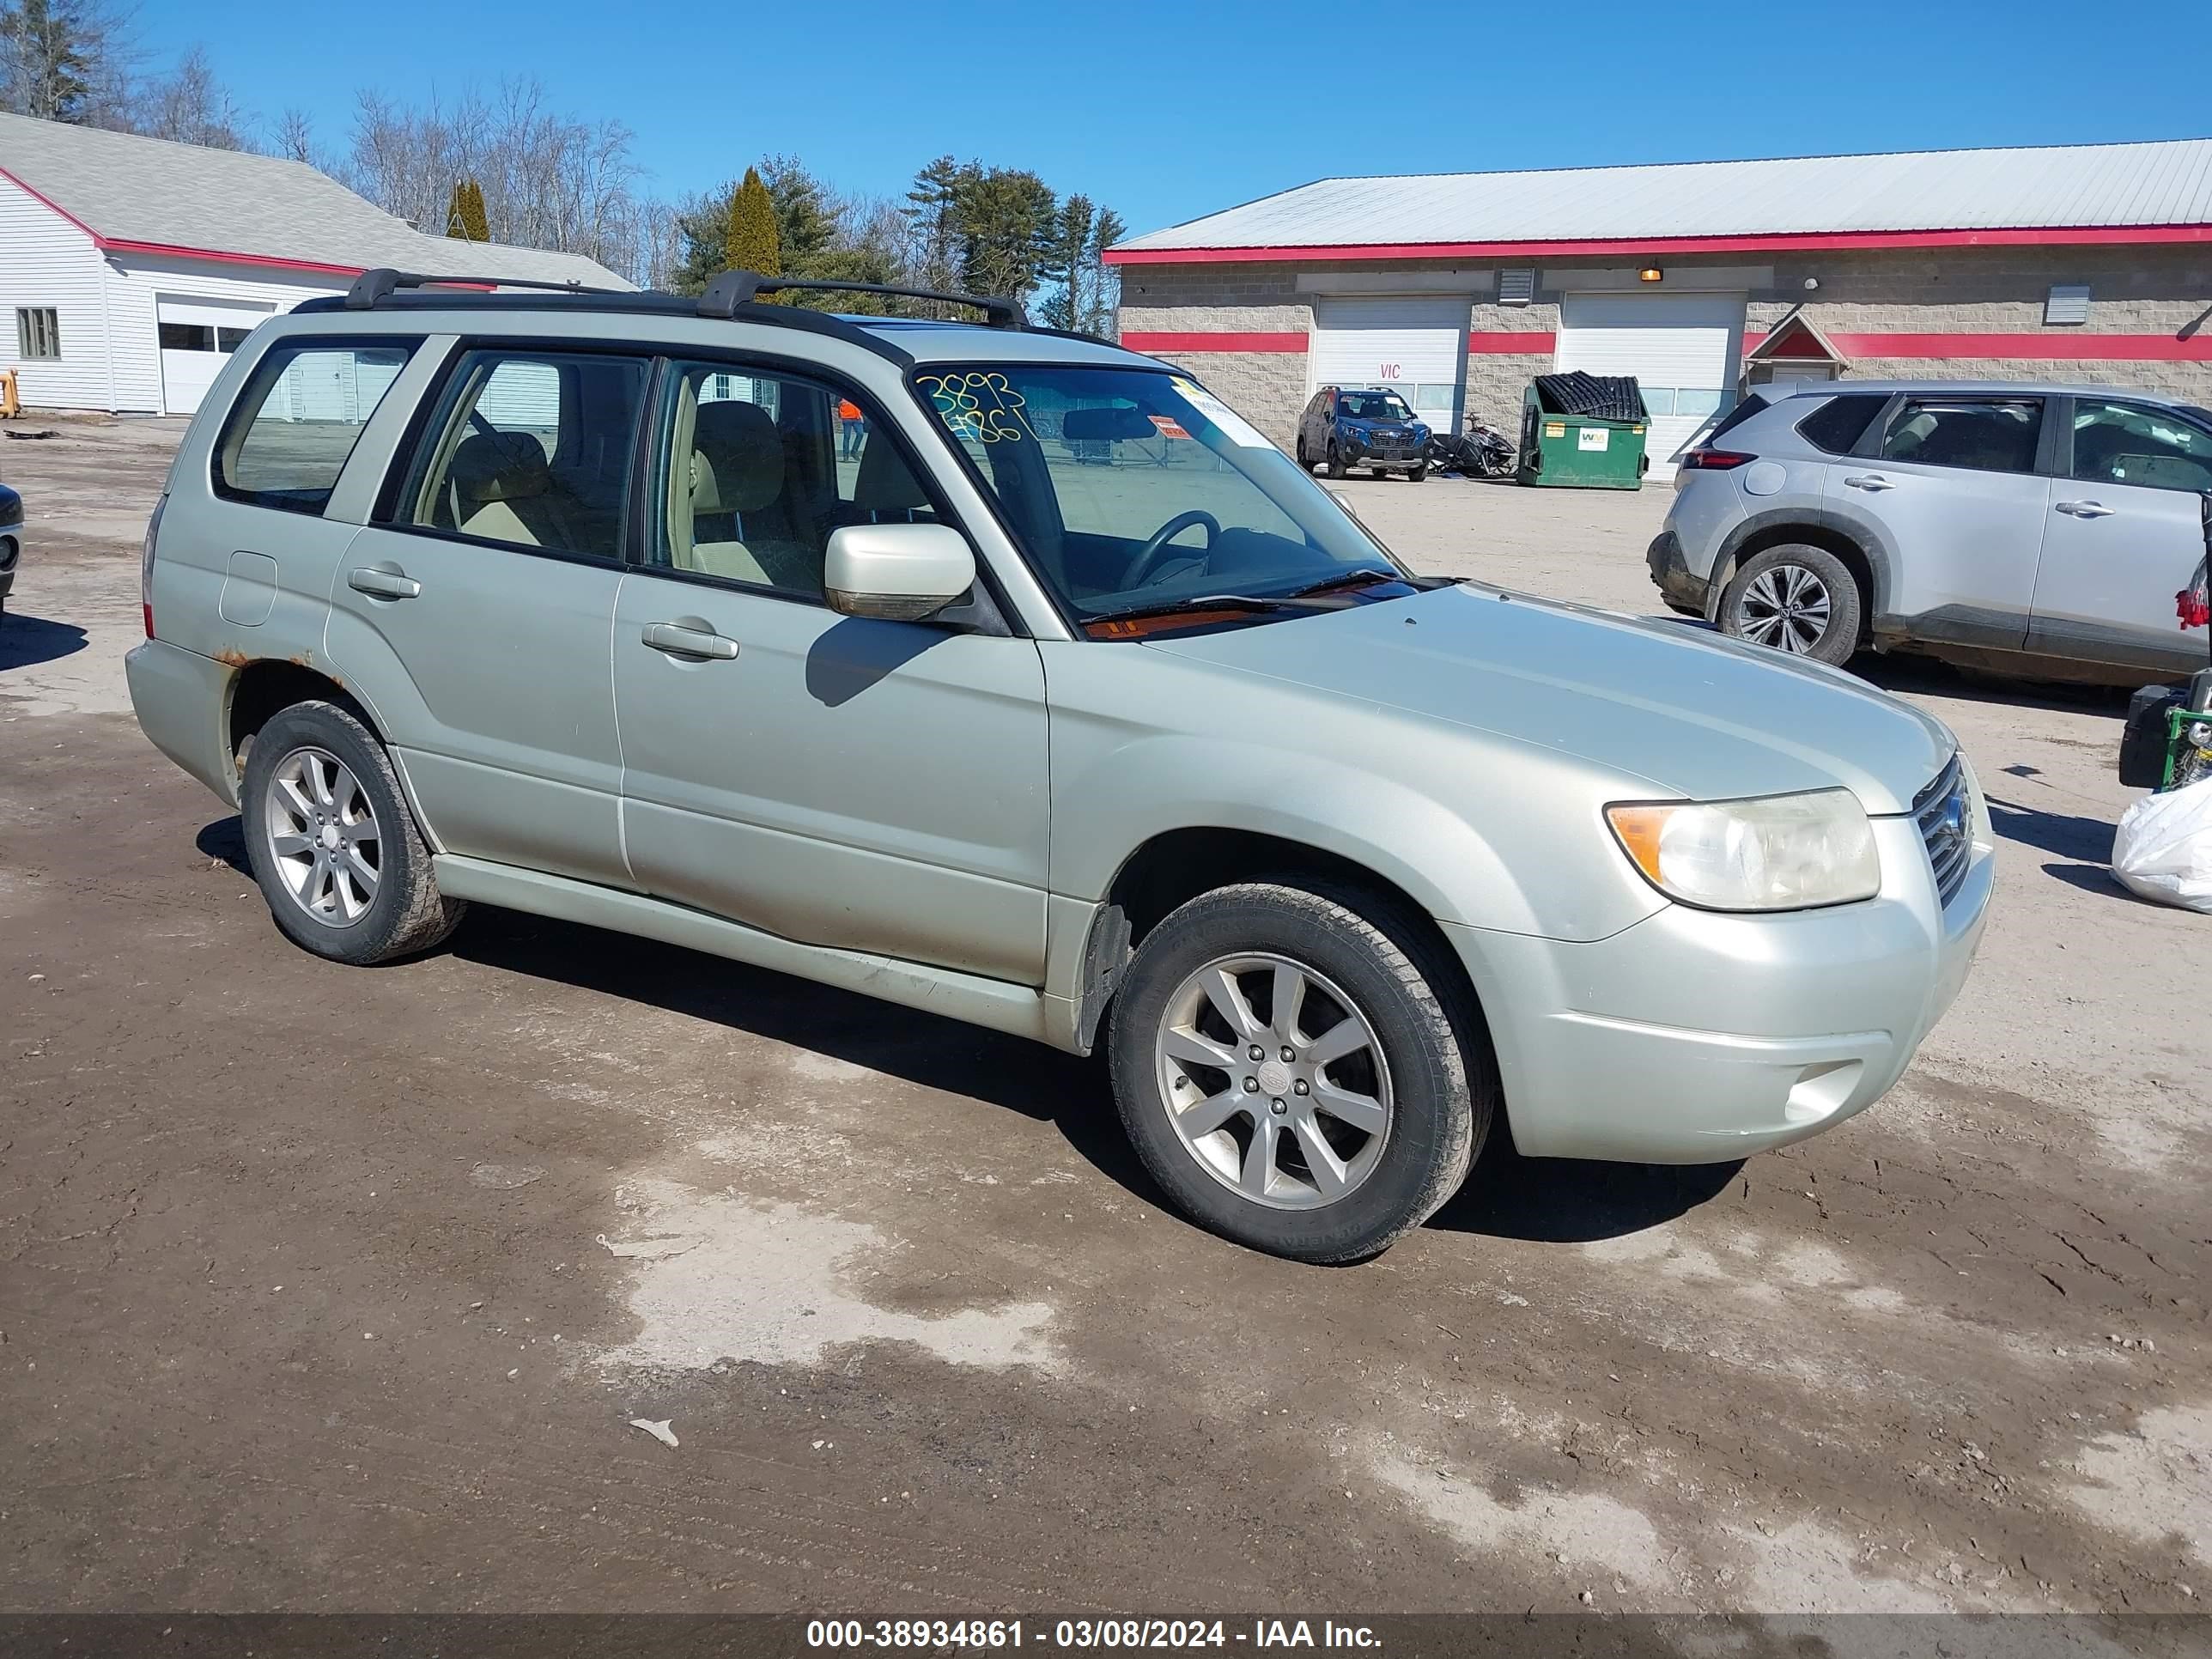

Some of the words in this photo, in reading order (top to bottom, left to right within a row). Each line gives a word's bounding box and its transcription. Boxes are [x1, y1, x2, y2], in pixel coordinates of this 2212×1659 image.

[1380, 363, 1401, 379] VIC
[915, 372, 1026, 414] 3893
[941, 407, 1040, 443] 4861
[1582, 433, 1606, 441] WM
